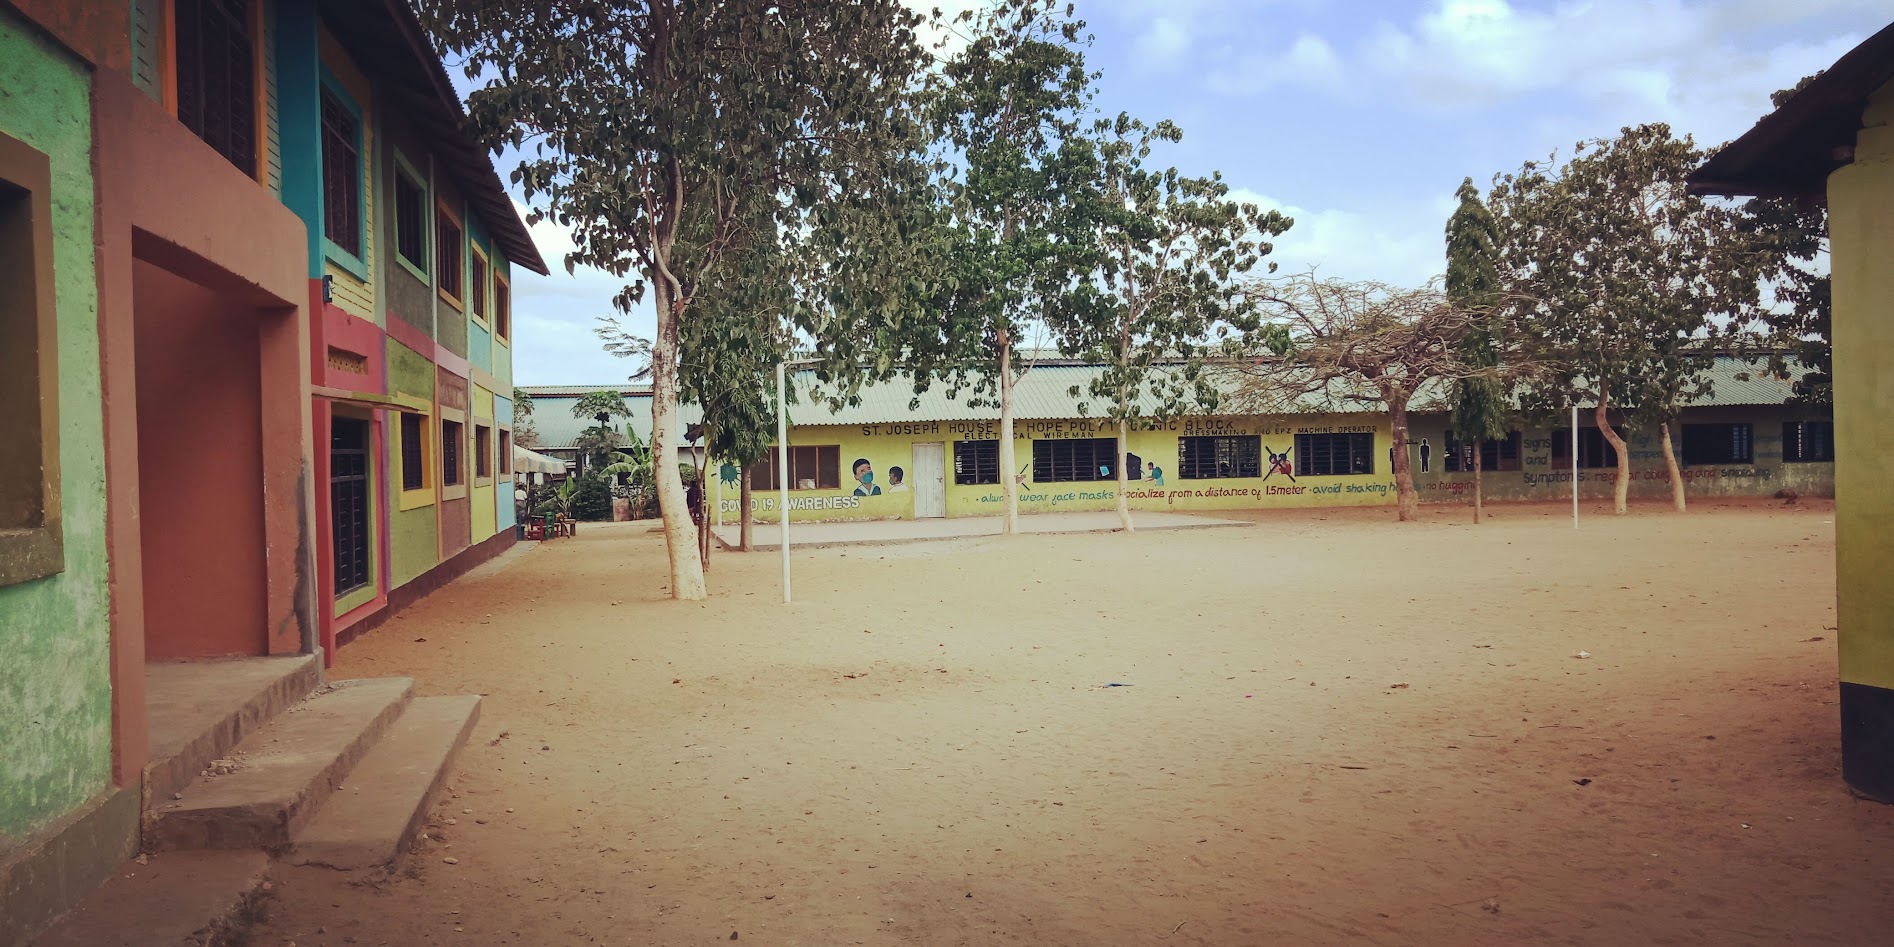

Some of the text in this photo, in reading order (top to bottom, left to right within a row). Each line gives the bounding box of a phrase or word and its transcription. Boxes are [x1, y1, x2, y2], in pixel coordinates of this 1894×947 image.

[863, 425, 881, 436] ST.
[886, 423, 939, 435] JOSEPH
[950, 422, 993, 434] HOUSE
[1027, 421, 1063, 433] HOPE
[1070, 419, 1177, 432] POLYTCNIC
[1185, 419, 1234, 431] BLOCK
[1275, 427, 1291, 435] EPZ
[1298, 426, 1333, 434] MACHINE
[1338, 425, 1377, 433] OPERATOR
[965, 431, 1094, 440] ELECTCAL WIREMAN
[1526, 453, 1548, 465] and
[1595, 472, 1640, 486] regar
[1644, 470, 1692, 483] cougng
[1695, 468, 1716, 478] and
[1020, 494, 1048, 502] wear
[1052, 492, 1076, 506] face
[1079, 490, 1114, 500] masks
[1125, 487, 1165, 499] ocialize
[1168, 489, 1192, 505] from
[1195, 490, 1203, 498] a
[1205, 486, 1248, 498] distance
[1251, 488, 1261, 501] of
[1312, 482, 1342, 494] avoid
[1346, 482, 1386, 497] shaking
[1425, 483, 1437, 491] no
[721, 498, 758, 512] COVD
[763, 498, 774, 511] 19
